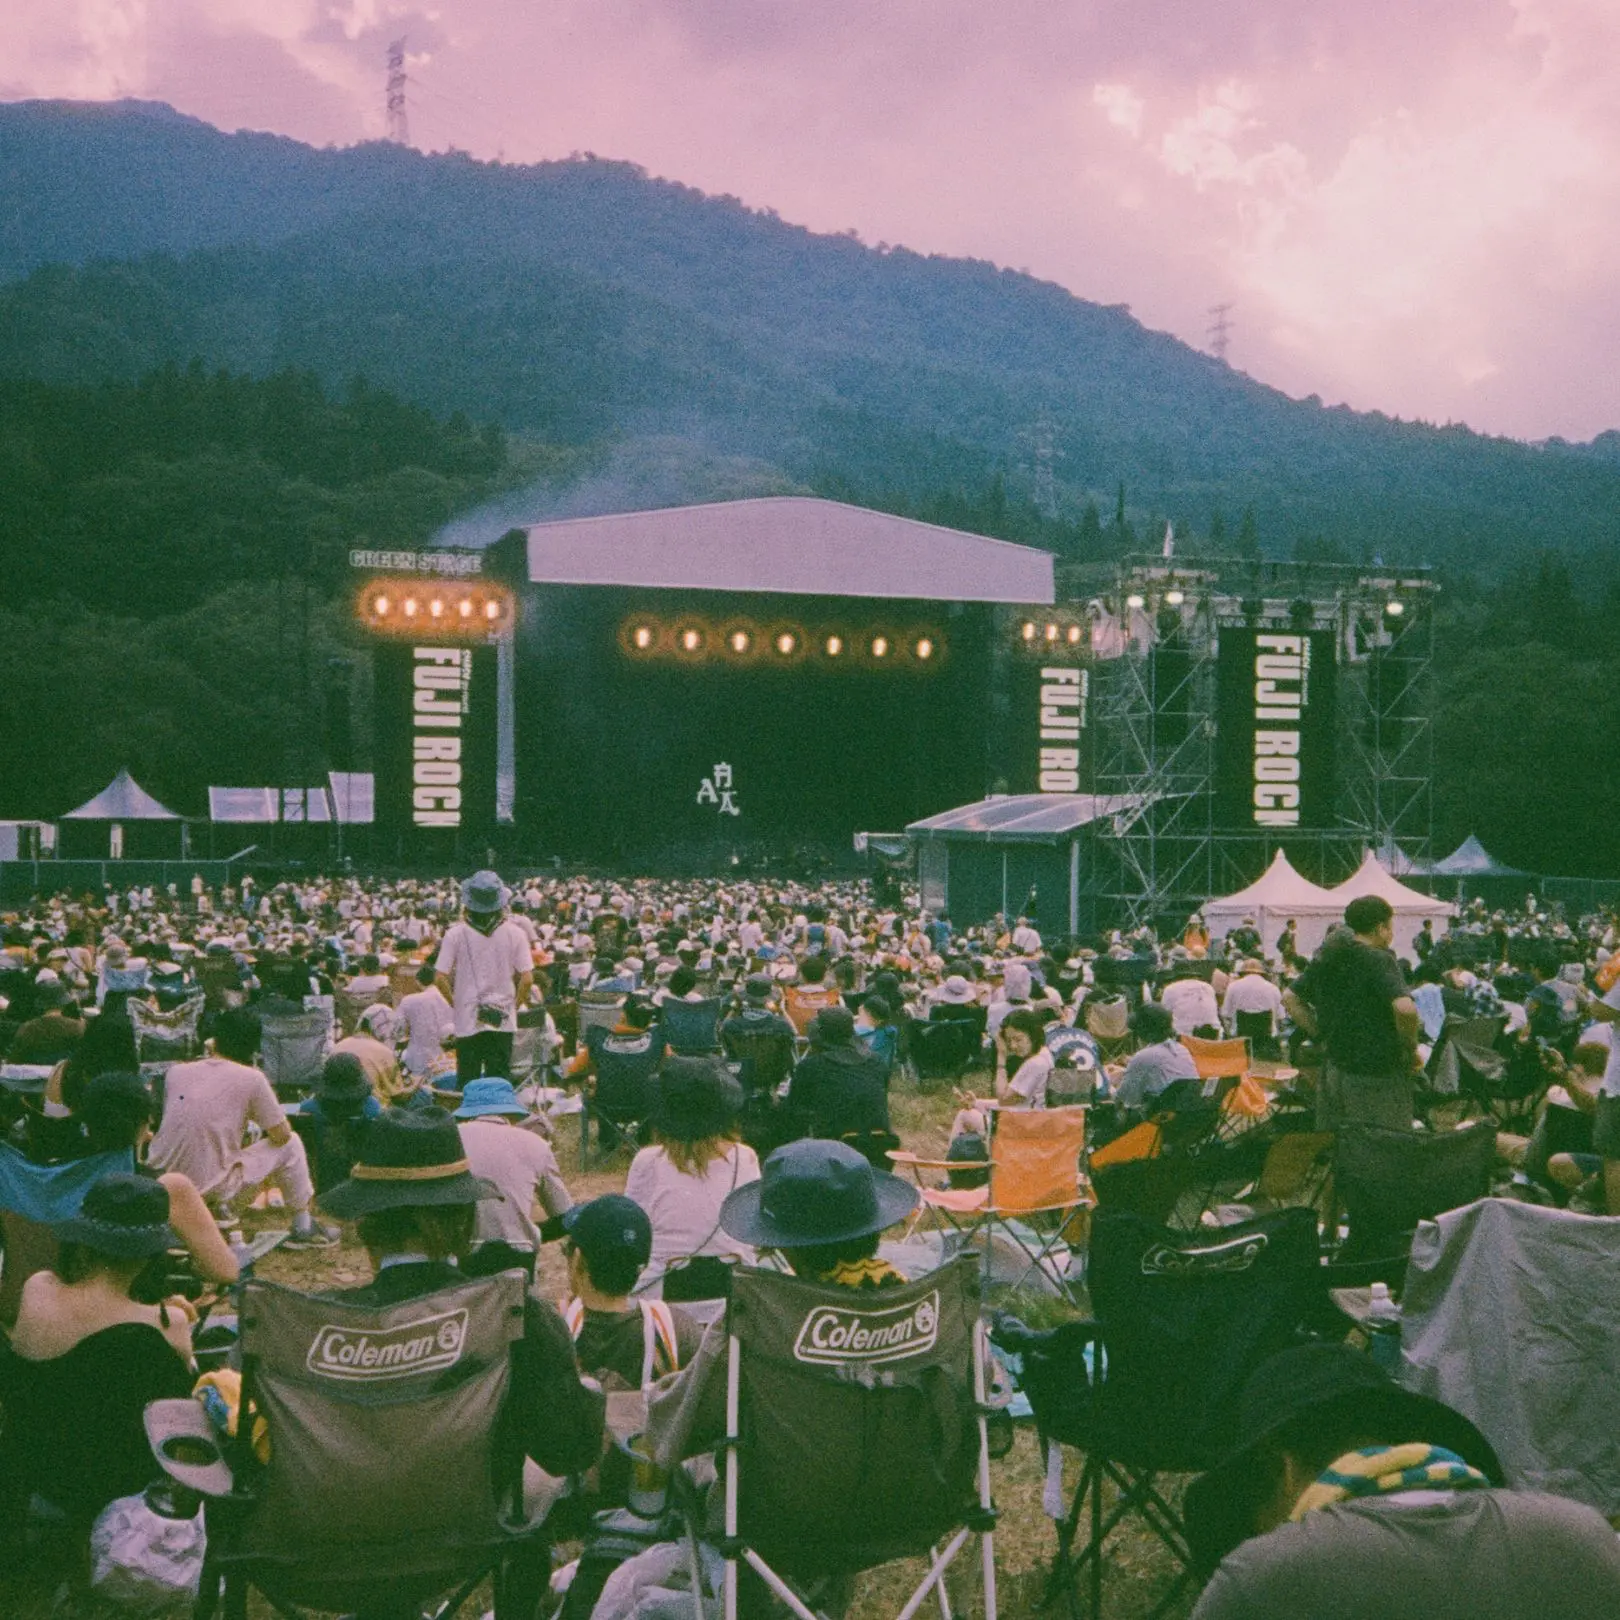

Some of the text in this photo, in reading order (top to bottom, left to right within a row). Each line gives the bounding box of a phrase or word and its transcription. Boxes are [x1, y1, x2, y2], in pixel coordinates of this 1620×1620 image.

[349, 549, 416, 569] GREEN
[413, 647, 461, 827] FUJI ROCK
[1039, 667, 1079, 792] FUJI RO
[1254, 634, 1300, 827] FUJI ROCK
[322, 1332, 434, 1367] Coleman
[812, 1314, 913, 1350] Coleman
